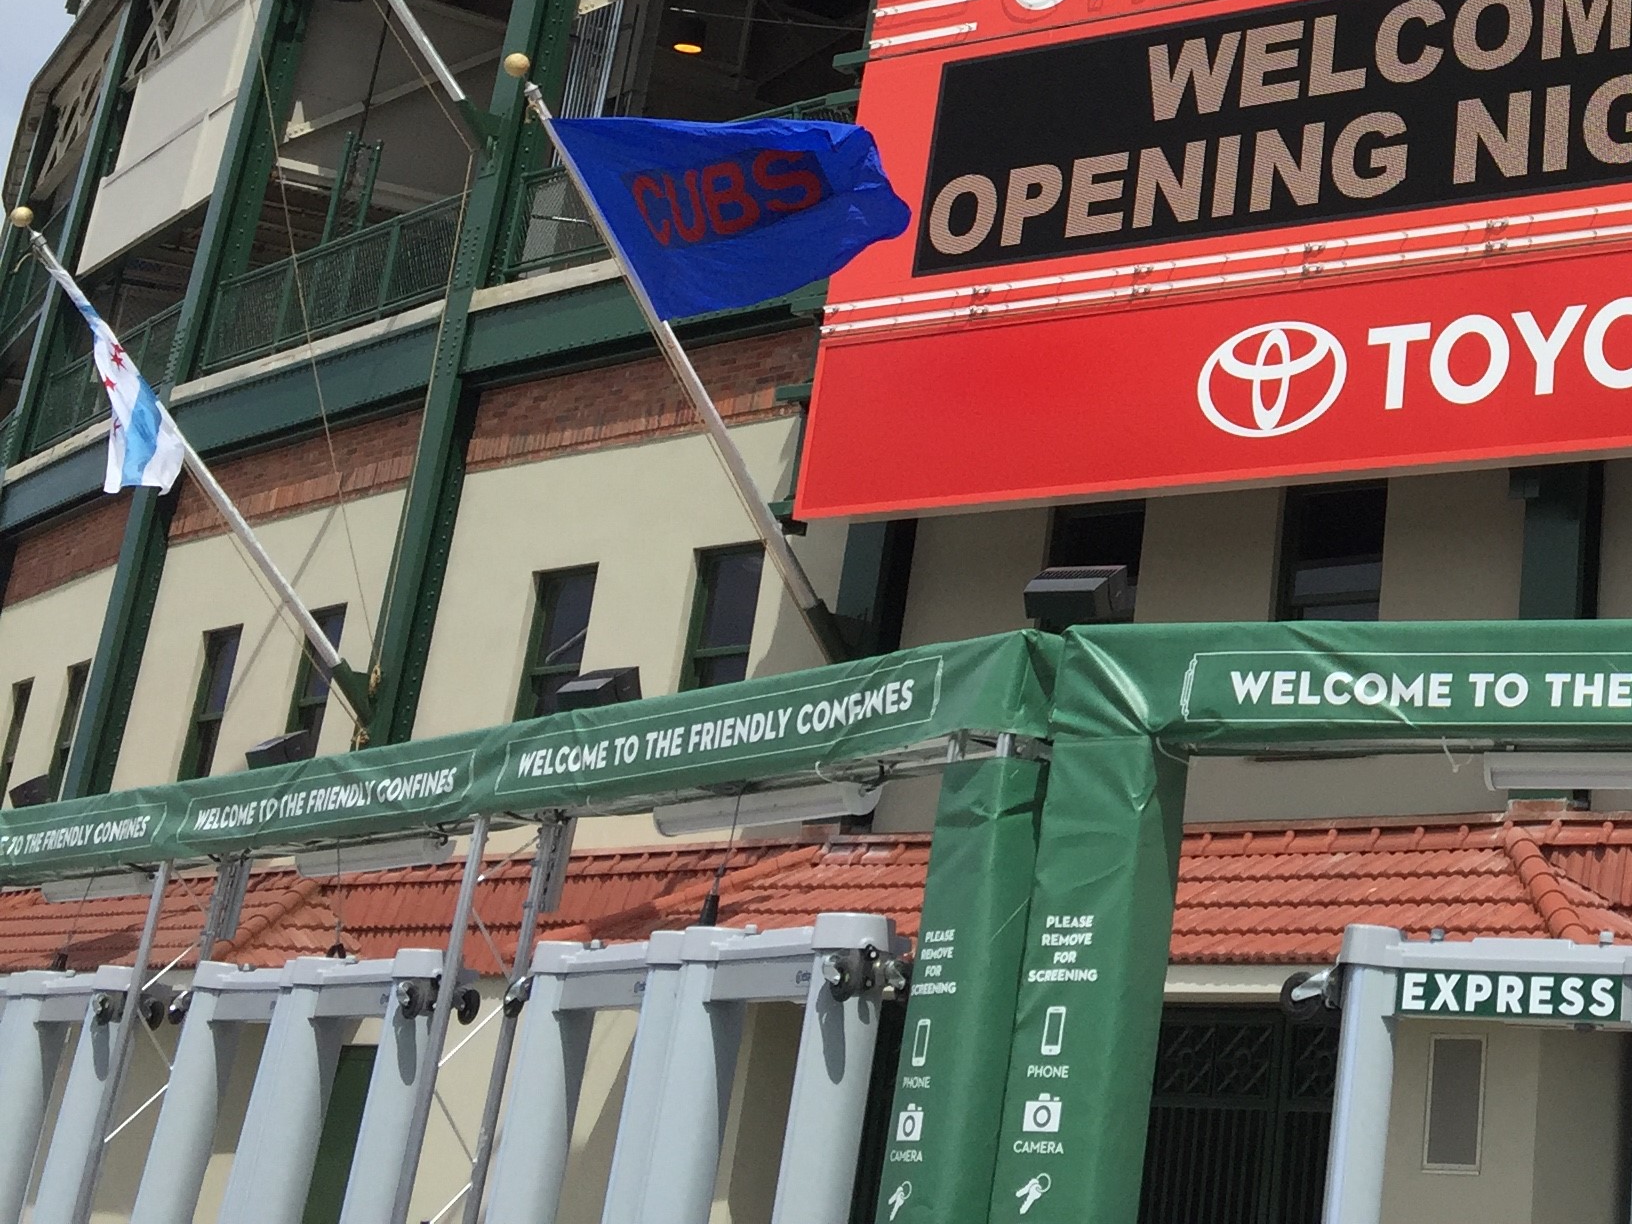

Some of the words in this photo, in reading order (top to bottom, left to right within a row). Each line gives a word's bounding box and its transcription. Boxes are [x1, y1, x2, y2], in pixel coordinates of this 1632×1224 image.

[928, 111, 1409, 256] OPENING
[631, 148, 823, 247] CUBS
[1230, 669, 1453, 708] WELCOME
[1468, 672, 1529, 708] TO
[1545, 672, 1632, 708] THE
[517, 740, 610, 778] WELCOME
[613, 735, 640, 766] TO
[645, 729, 683, 761] THE
[688, 706, 793, 753] FRIENDLY
[797, 678, 915, 734] CONFINES
[194, 803, 257, 831] WELCOME
[258, 796, 278, 823] TO
[279, 790, 305, 819] THE
[306, 779, 376, 815] FRIENDLY
[376, 766, 457, 803] CONFINES
[24, 831, 45, 855] THE
[41, 823, 95, 851] FRIENDLY
[1045, 915, 1095, 929] PLEASE
[924, 928, 956, 944] PLEASE
[1041, 932, 1093, 947] REMOVE
[920, 946, 955, 961] REMOVE
[1053, 950, 1077, 964] FOR
[924, 964, 942, 977] FOR
[1027, 968, 1099, 983] SCREENING
[910, 981, 957, 997] SCREENING
[1401, 971, 1617, 1018] EXPRESS
[1027, 1064, 1070, 1079] PHONE
[902, 1076, 931, 1089] PHONE
[1013, 1140, 1065, 1155] CAMERA
[889, 1149, 923, 1163] CAMERA
